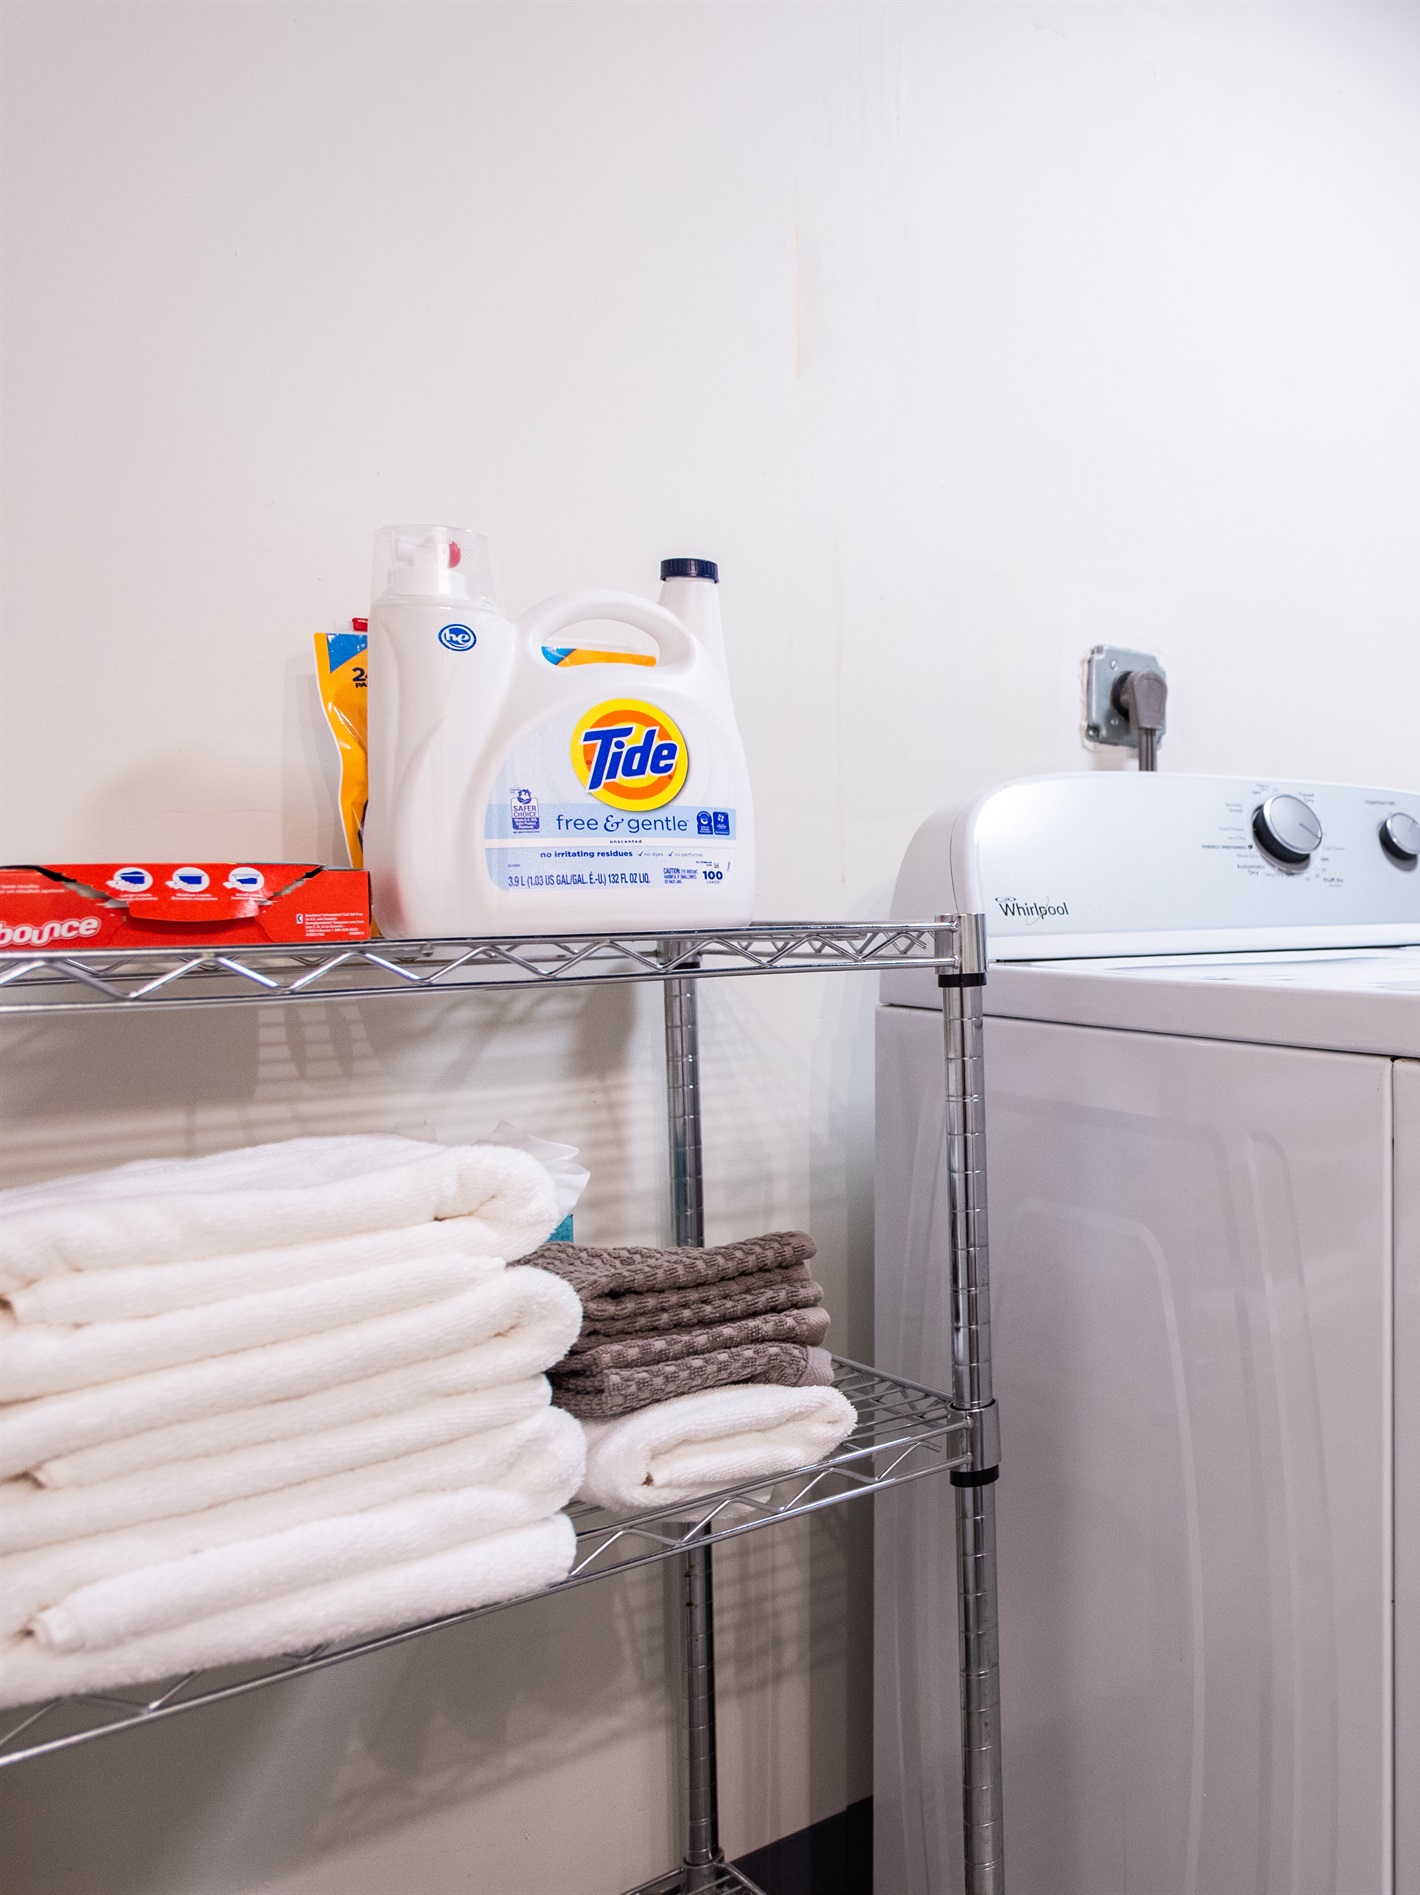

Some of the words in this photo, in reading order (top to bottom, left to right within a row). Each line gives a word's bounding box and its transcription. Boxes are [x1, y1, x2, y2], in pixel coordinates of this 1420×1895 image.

[352, 667, 368, 682] 2
[582, 726, 678, 790] Tide
[556, 814, 599, 830] free
[603, 814, 624, 832] &
[627, 816, 688, 833] gentle
[554, 850, 594, 858] irritating
[508, 875, 520, 887] 3.9
[520, 876, 525, 886] L
[527, 875, 544, 888] (1.03
[545, 875, 555, 886] US
[556, 873, 588, 885] GAL/GAL.
[608, 873, 619, 884] 132
[620, 873, 628, 884] FL
[629, 873, 638, 884] OZ
[639, 873, 651, 884] LIQ.
[702, 871, 723, 880] 100
[999, 902, 1069, 920] Whirlpool
[0, 918, 100, 945] bounce
